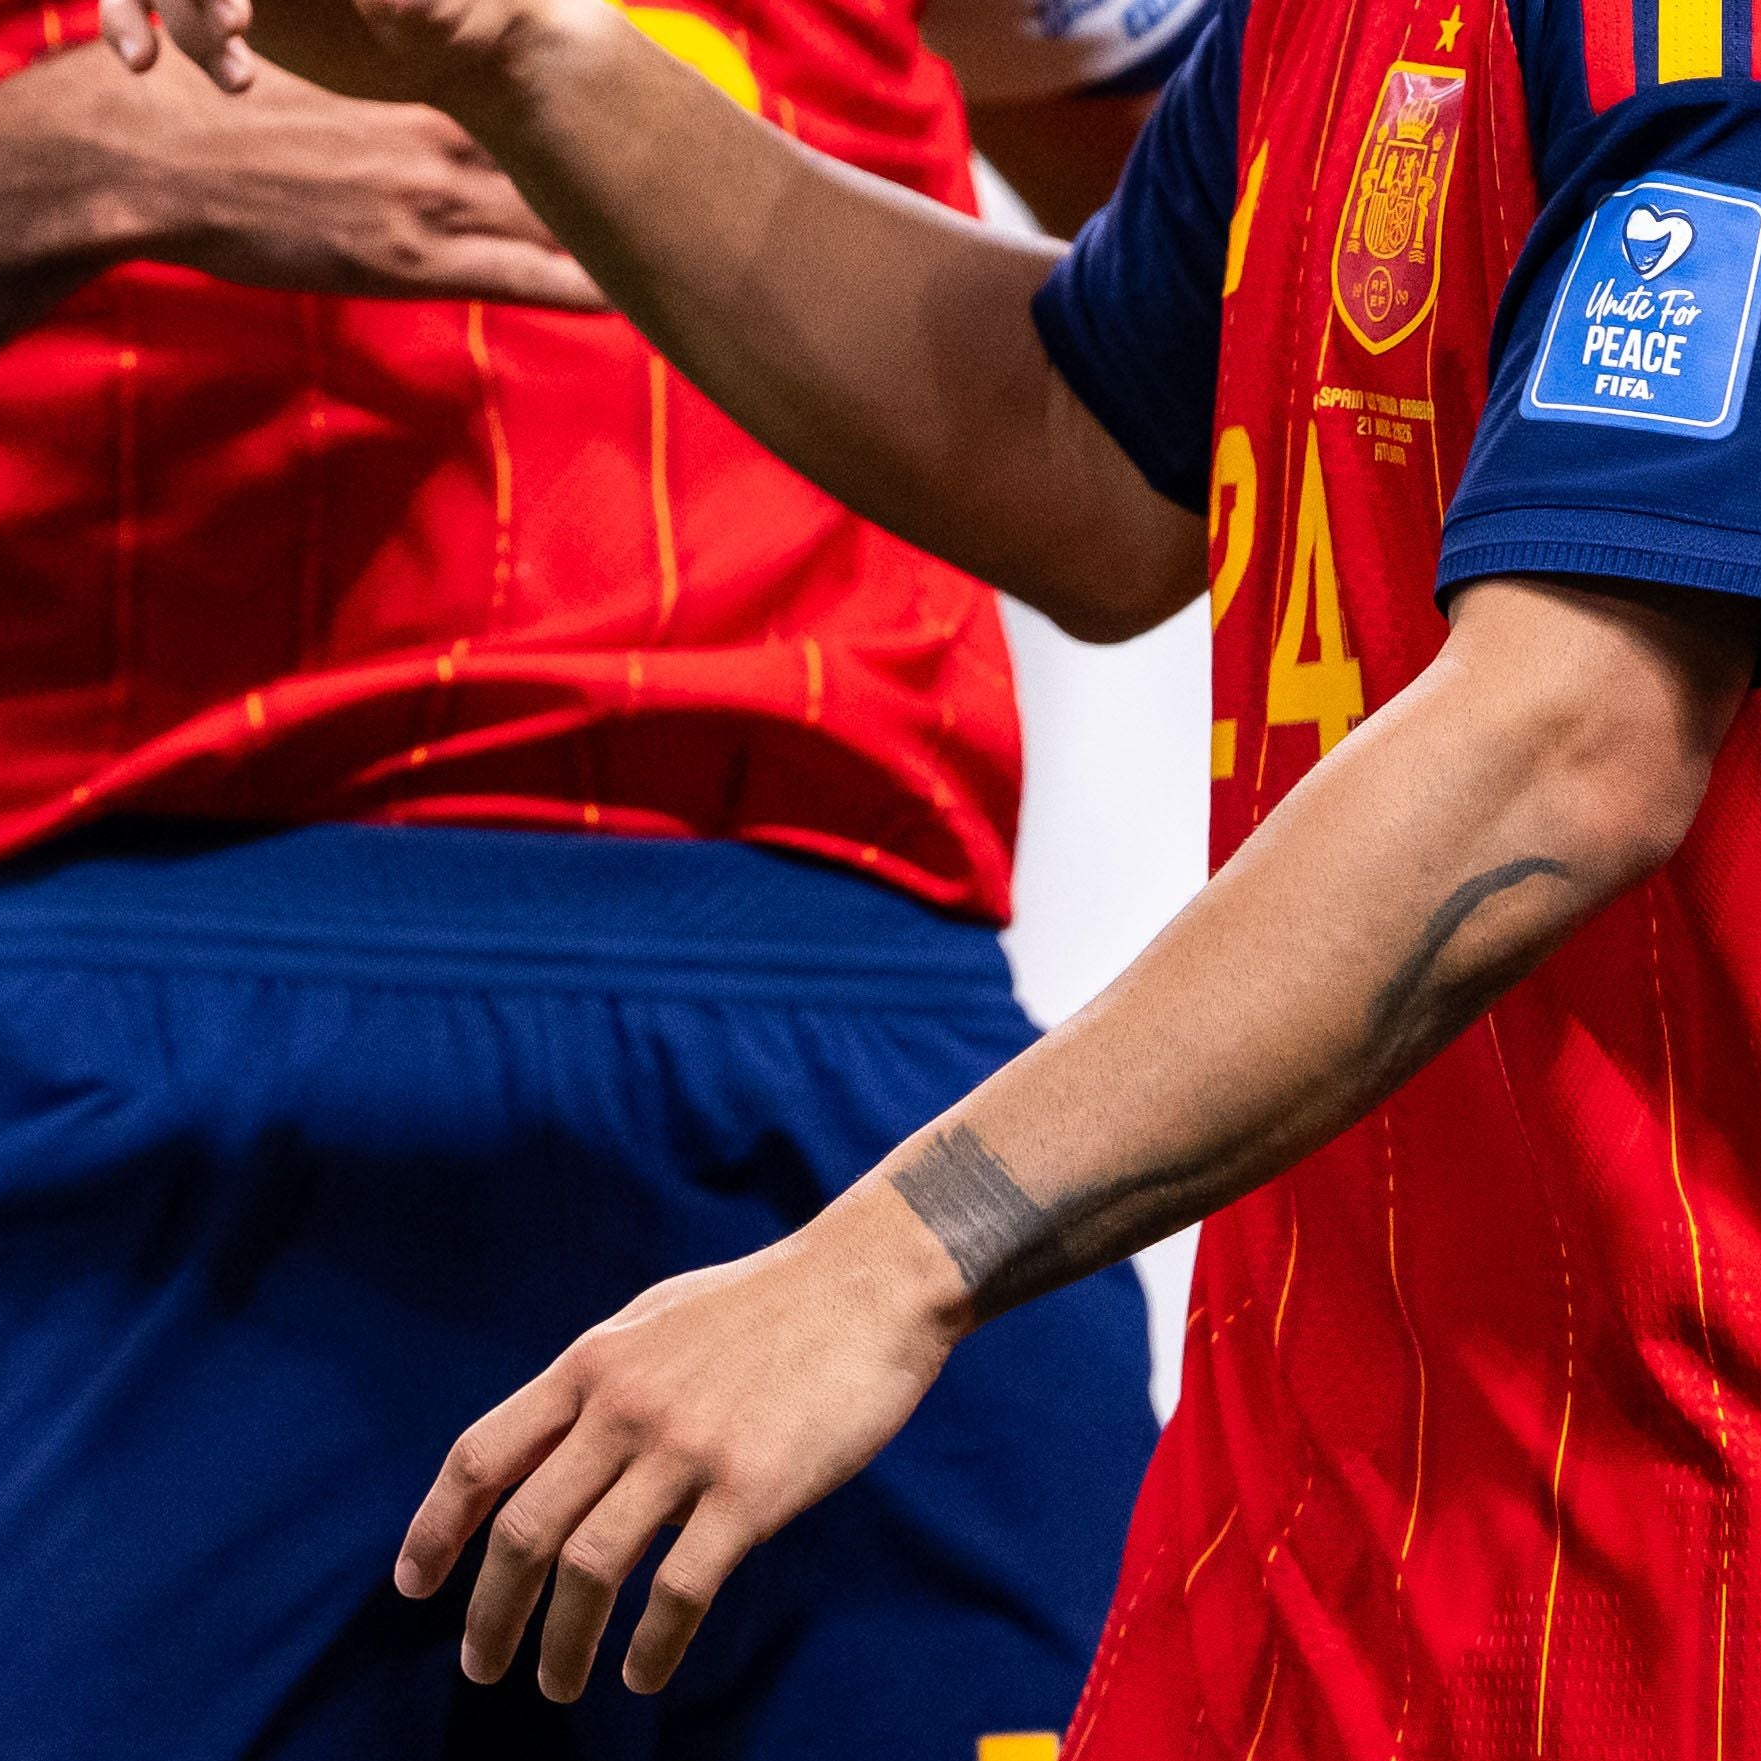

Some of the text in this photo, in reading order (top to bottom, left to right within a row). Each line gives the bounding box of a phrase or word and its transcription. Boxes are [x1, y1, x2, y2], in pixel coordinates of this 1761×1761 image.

[1585, 278, 1702, 330] Unite For
[1582, 325, 1688, 376] PEACE
[1319, 386, 1364, 410] SPAIN
[1595, 374, 1652, 400] FIFA
[1356, 416, 1372, 435] 21
[1209, 419, 1365, 780] 24
